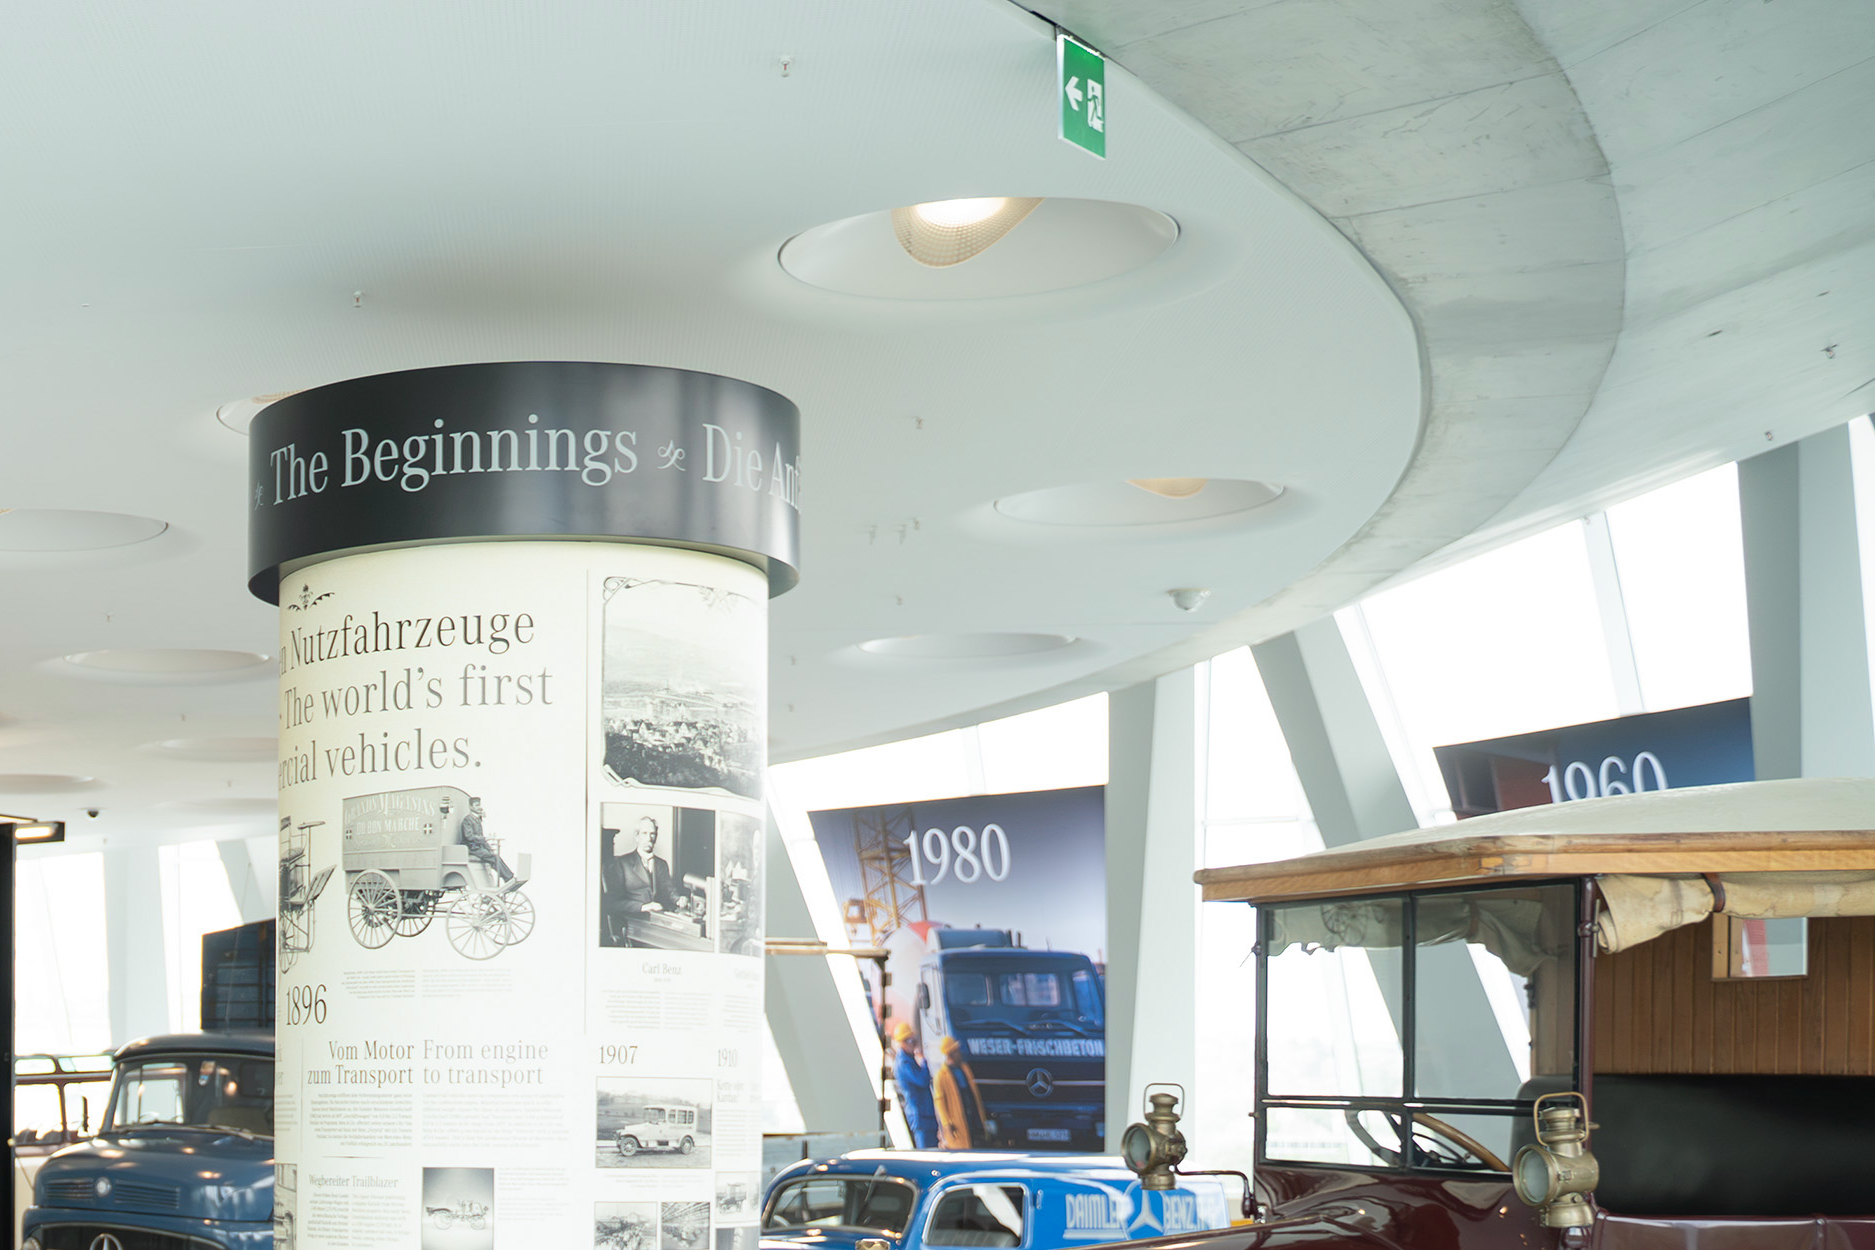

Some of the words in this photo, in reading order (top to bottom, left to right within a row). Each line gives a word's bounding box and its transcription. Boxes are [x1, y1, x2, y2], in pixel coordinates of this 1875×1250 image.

[270, 441, 329, 506] The
[341, 413, 638, 492] Beginnings
[702, 423, 763, 492] Die
[290, 610, 535, 671] Nutzfahrzeuge
[285, 687, 315, 730] The
[458, 663, 554, 708] first
[325, 728, 481, 778] vehicles.
[1541, 751, 1670, 804] 1960
[902, 822, 1012, 887] 1980
[641, 962, 660, 975] Carl
[662, 963, 682, 976] Benz
[286, 983, 327, 1026] 1896
[328, 1040, 358, 1060] Vom
[364, 1040, 415, 1061] Motor
[423, 1039, 473, 1060] From
[480, 1039, 549, 1064] engine
[599, 1044, 638, 1065] 1907
[307, 1070, 331, 1085] zum
[335, 1064, 414, 1088] Transport
[423, 1066, 441, 1085] to
[448, 1066, 544, 1088] transport
[308, 1173, 350, 1189] Wegbereiter
[352, 1175, 399, 1188] Trailblazer
